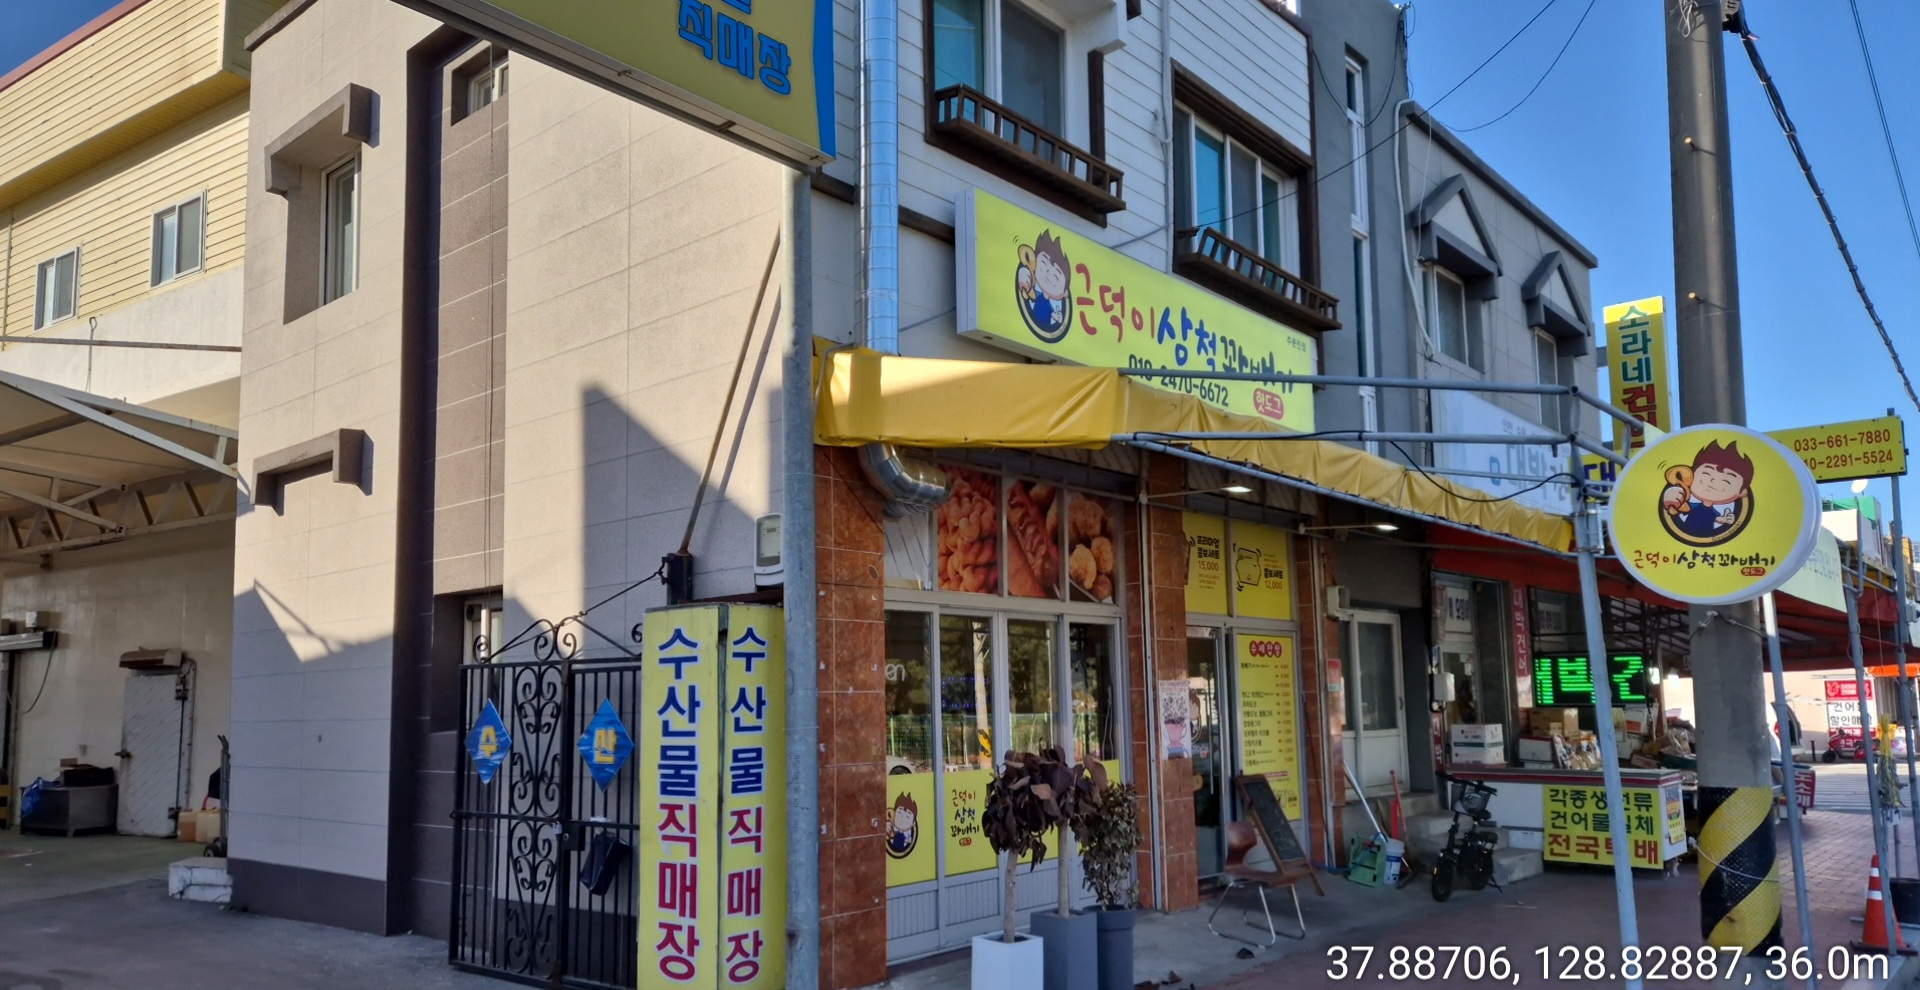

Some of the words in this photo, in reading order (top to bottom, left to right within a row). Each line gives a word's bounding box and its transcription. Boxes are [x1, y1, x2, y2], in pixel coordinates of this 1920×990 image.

[678, 0, 791, 95] 직매장
[1255, 390, 1282, 415] 핫도그
[1794, 428, 1891, 453] 033-661-7880
[1198, 560, 1219, 572] 15,000
[1265, 580, 1282, 590] 12,000
[478, 725, 498, 759] 수
[593, 727, 617, 764] 산
[656, 627, 700, 981] 수산물직매장
[725, 627, 768, 983] 수산물직매장
[951, 788, 976, 807] 근덕이
[954, 806, 976, 824] 삼척
